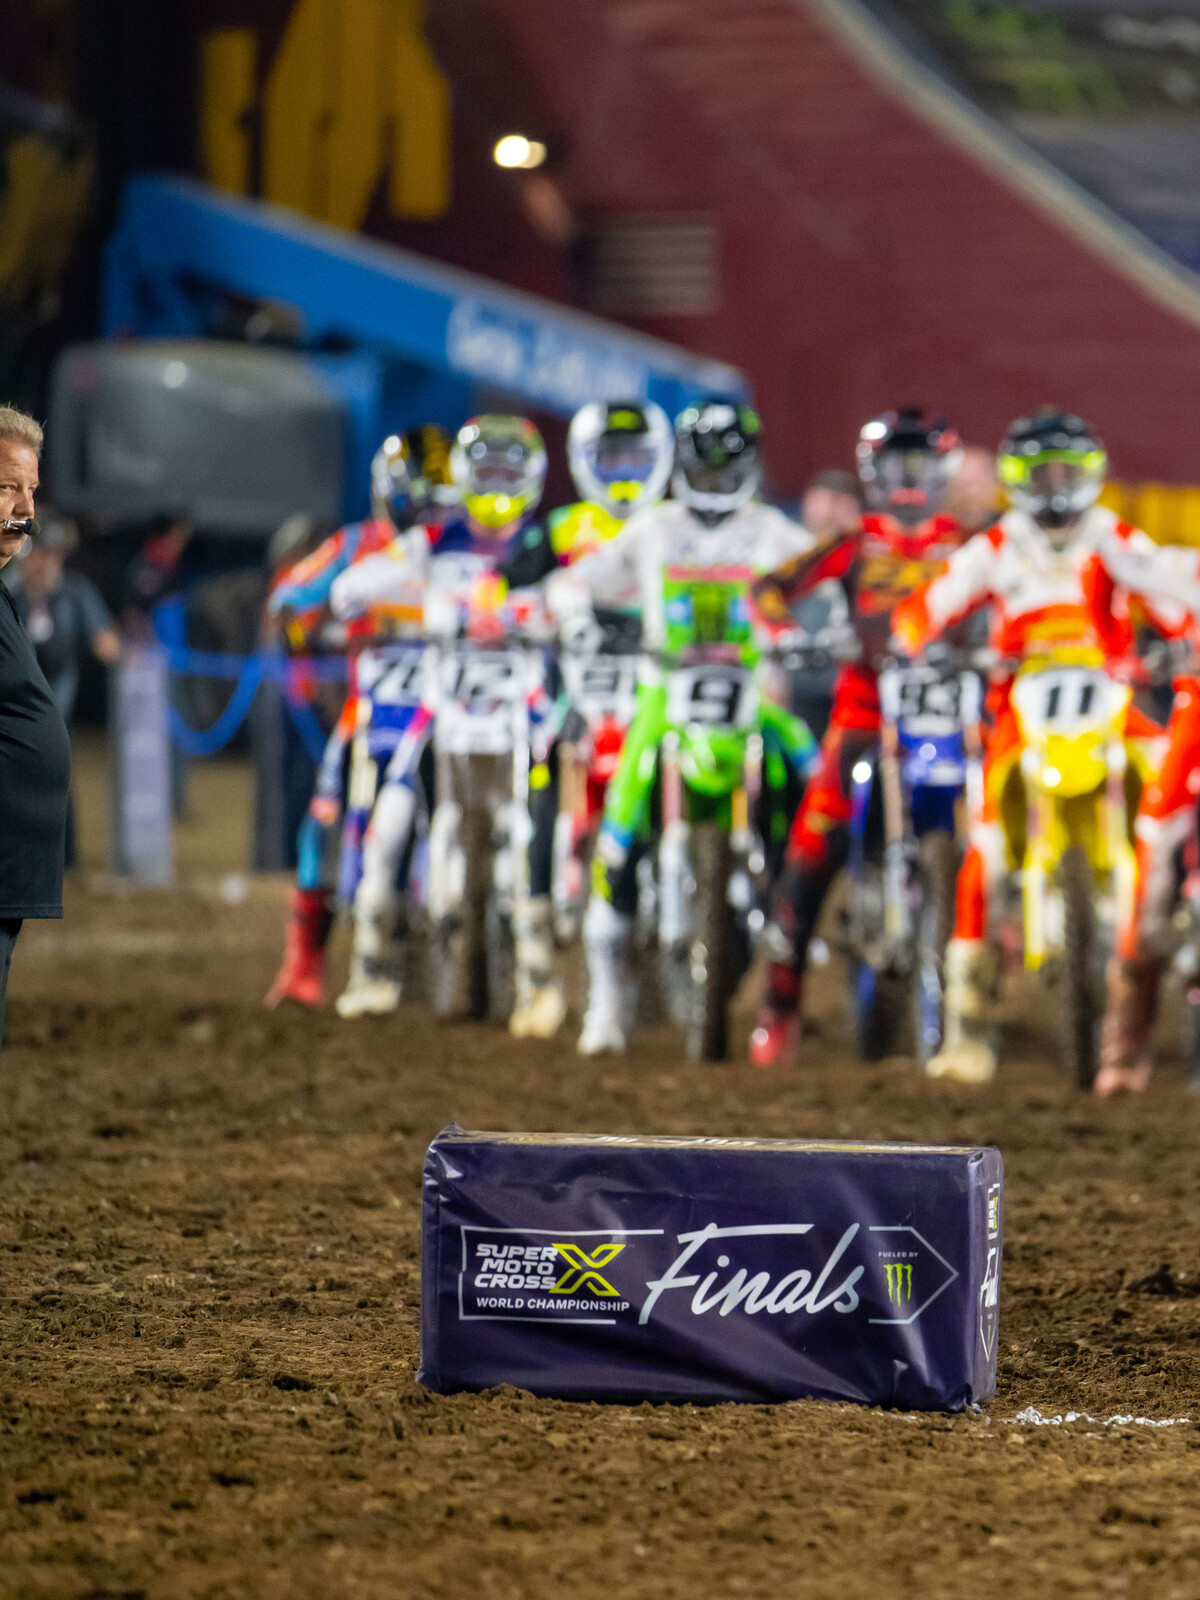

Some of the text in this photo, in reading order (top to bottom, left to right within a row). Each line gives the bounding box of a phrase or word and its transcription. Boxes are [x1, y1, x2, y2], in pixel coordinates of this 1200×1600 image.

[1046, 683, 1093, 720] 11
[475, 1243, 558, 1261] SUPER
[481, 1258, 554, 1275] MOTO
[639, 1222, 865, 1326] Finals
[474, 1273, 557, 1290] CROSS
[476, 1297, 630, 1311] WORLD CHAMPIONSHIP
